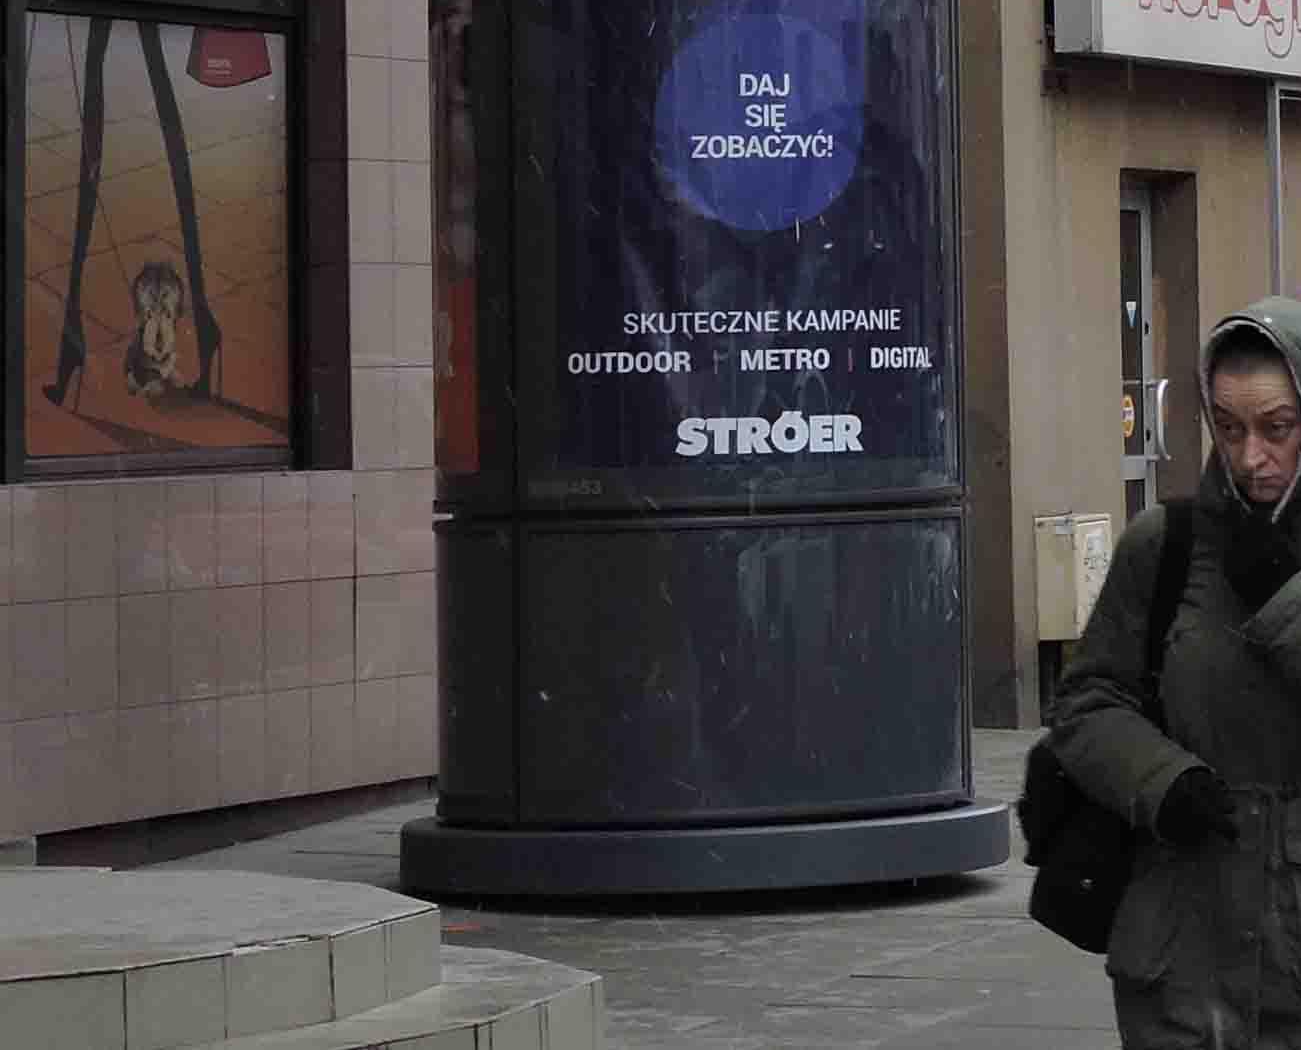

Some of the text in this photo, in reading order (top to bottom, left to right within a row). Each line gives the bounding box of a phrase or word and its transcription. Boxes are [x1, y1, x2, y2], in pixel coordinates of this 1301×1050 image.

[738, 73, 791, 97] DAJ
[744, 104, 787, 133] SIĘ
[690, 129, 834, 160] ZOBACZYĆ!
[623, 308, 902, 336] SKUTECZNE KAMPANIE
[567, 346, 933, 376] OUTDOOR METRO DIGITAL
[675, 410, 864, 456] STRÖER
